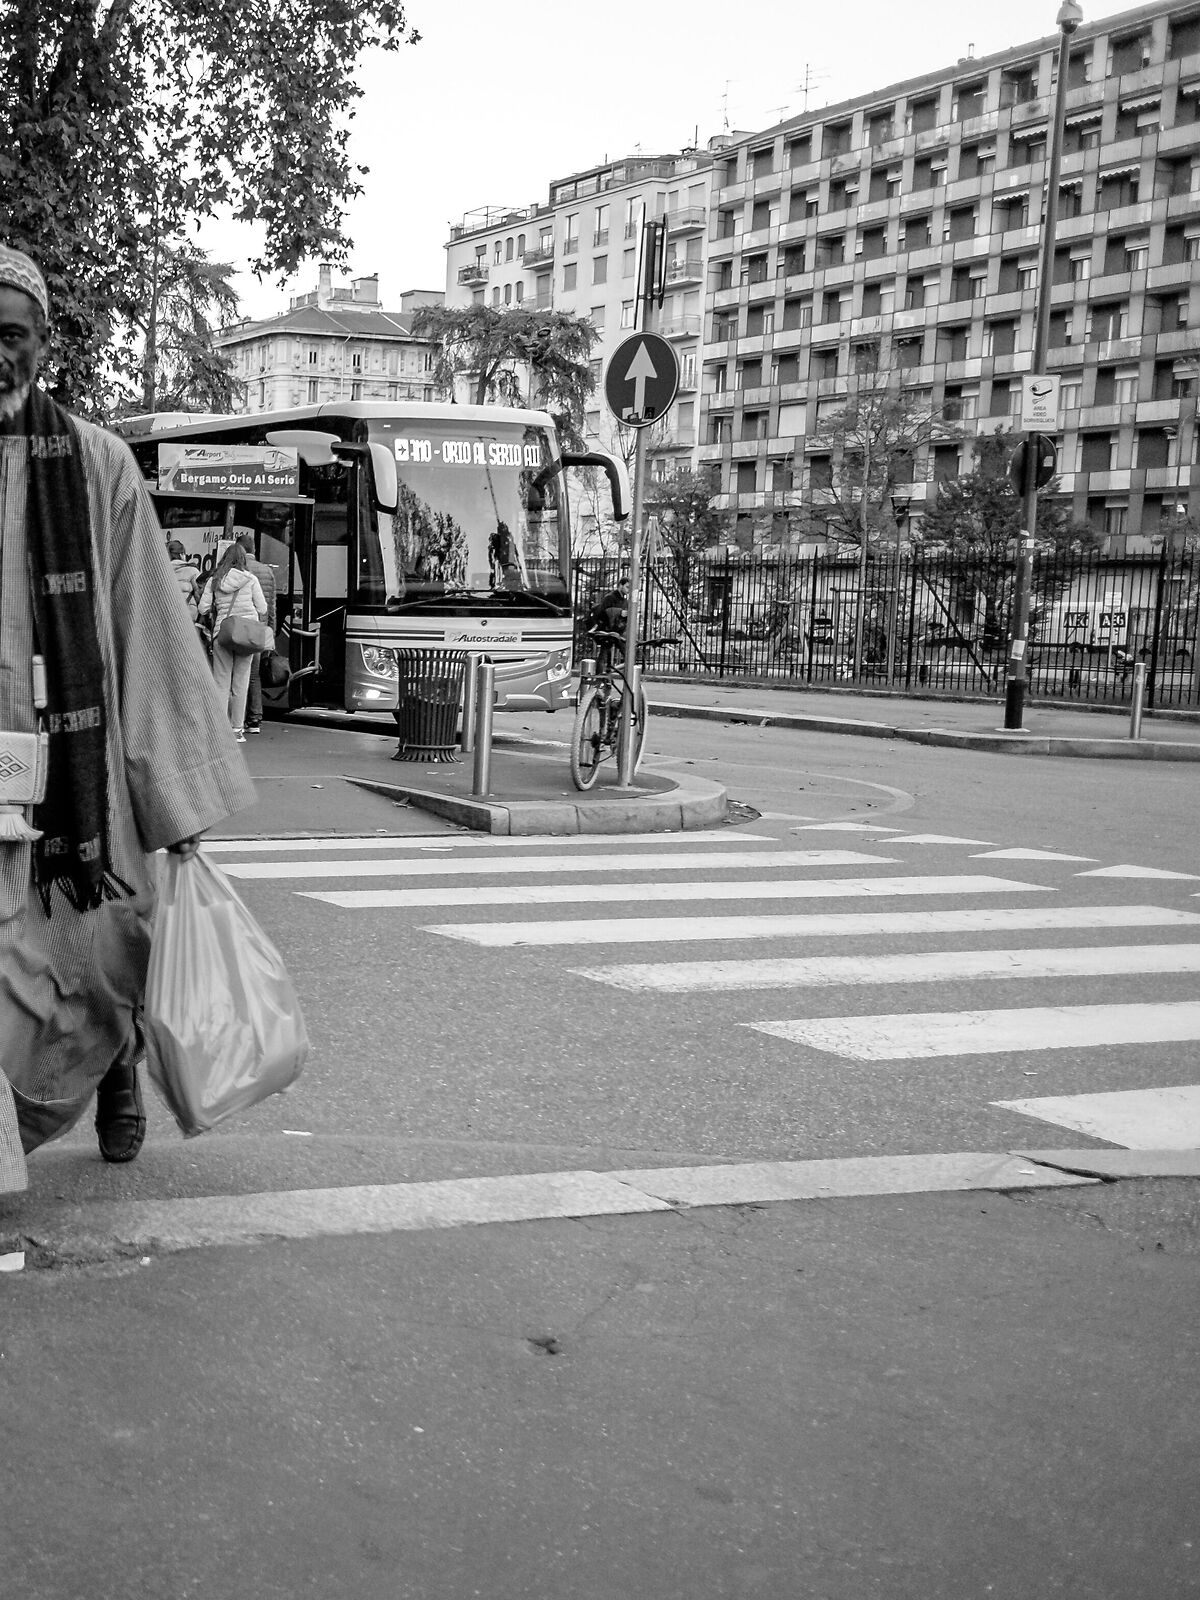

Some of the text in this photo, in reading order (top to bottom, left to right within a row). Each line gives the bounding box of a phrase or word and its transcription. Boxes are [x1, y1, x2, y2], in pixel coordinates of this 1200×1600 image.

[442, 441, 471, 464] ORIO
[473, 442, 487, 465] AL
[489, 442, 522, 467] SERIO
[180, 473, 295, 486] Bergamo Orio Al Serio
[458, 634, 518, 643] Autostradale
